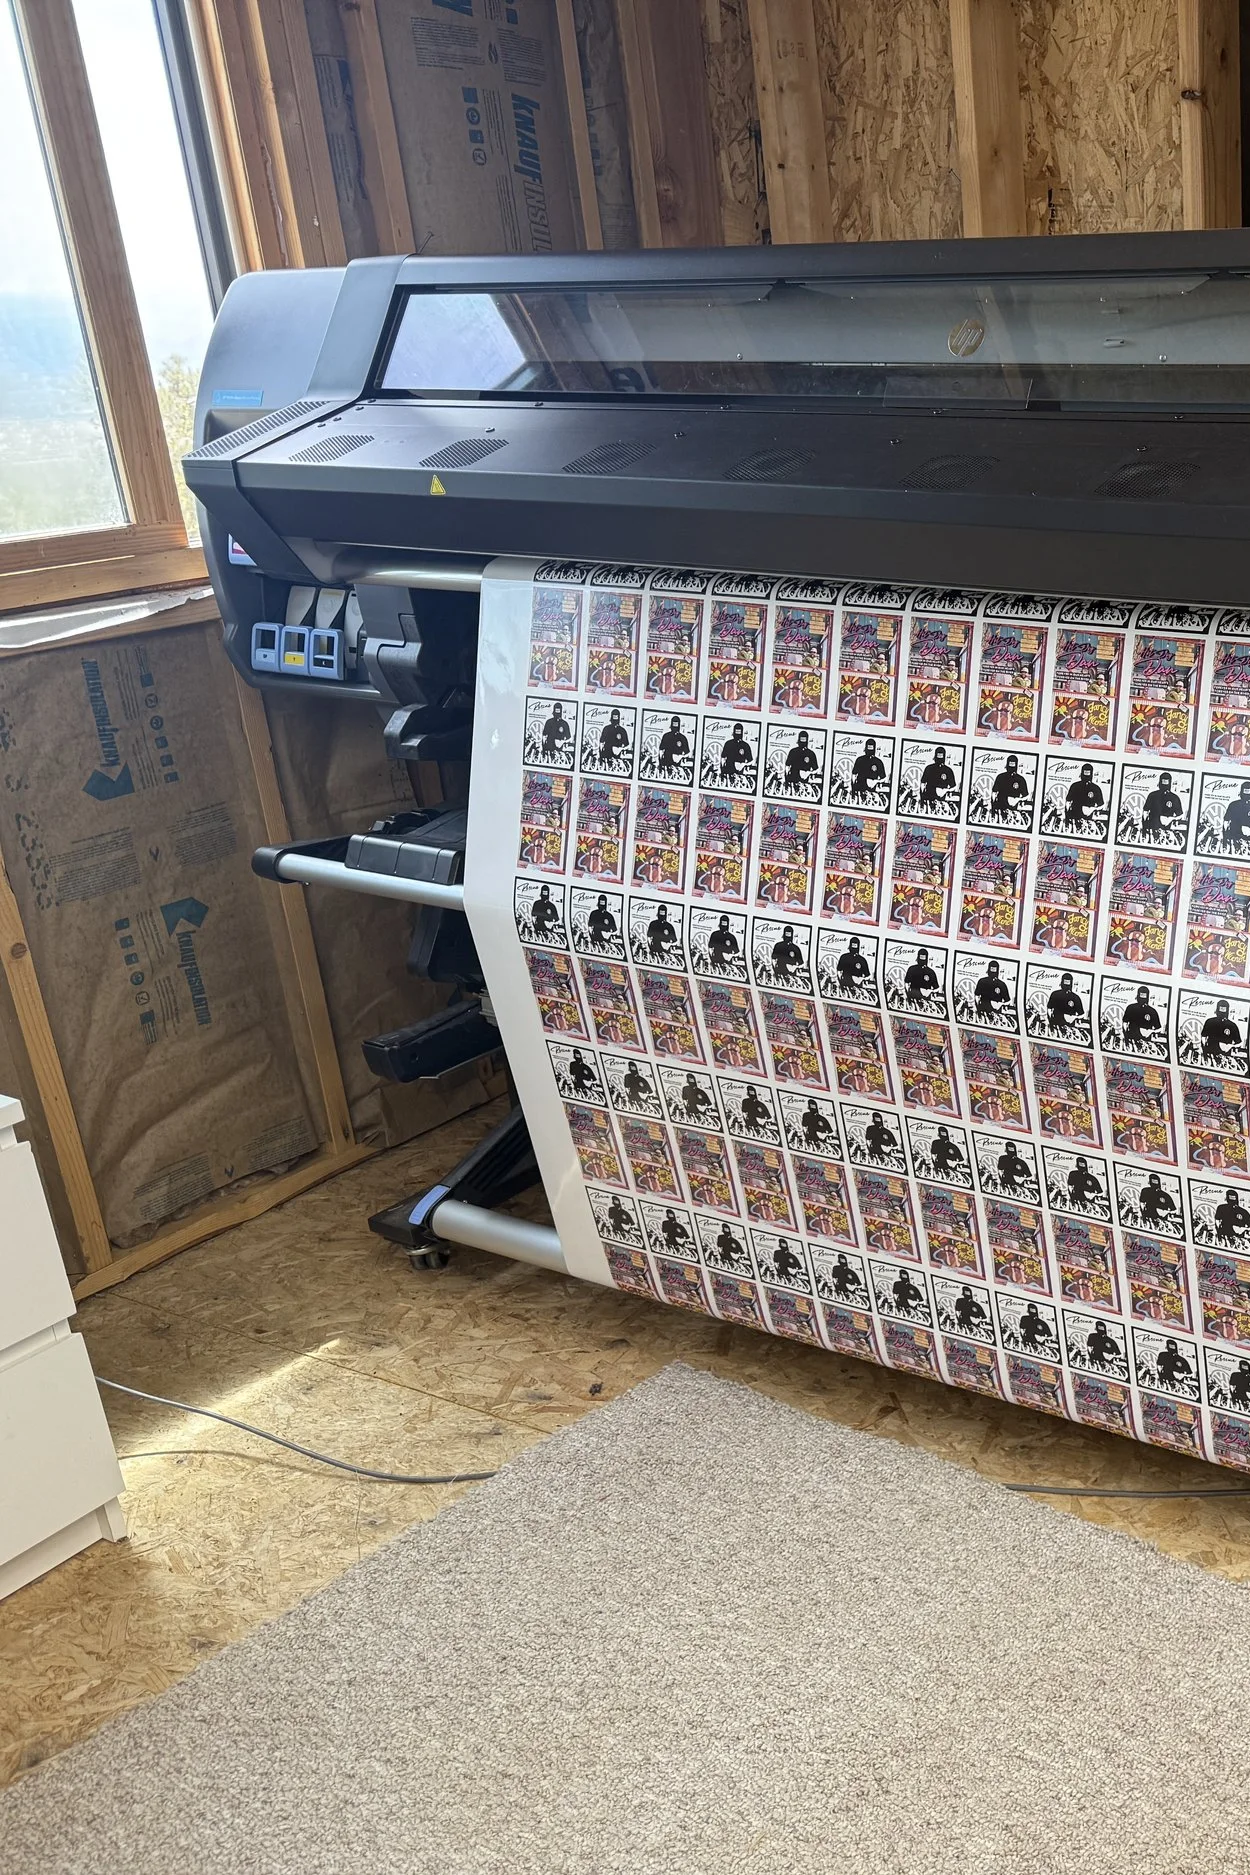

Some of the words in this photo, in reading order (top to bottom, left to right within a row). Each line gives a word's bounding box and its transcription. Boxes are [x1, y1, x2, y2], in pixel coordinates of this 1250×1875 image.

[1056, 650, 1099, 669] Dan
[1134, 656, 1178, 676] Dan
[1204, 780, 1238, 793] Rescue
[1038, 862, 1079, 880] Dan
[1112, 873, 1156, 892] Dan
[1191, 885, 1237, 904] Dan
[1182, 996, 1215, 1008] Rescue
[1191, 1185, 1223, 1195] Rescue
[1207, 1354, 1237, 1362] Rescue
